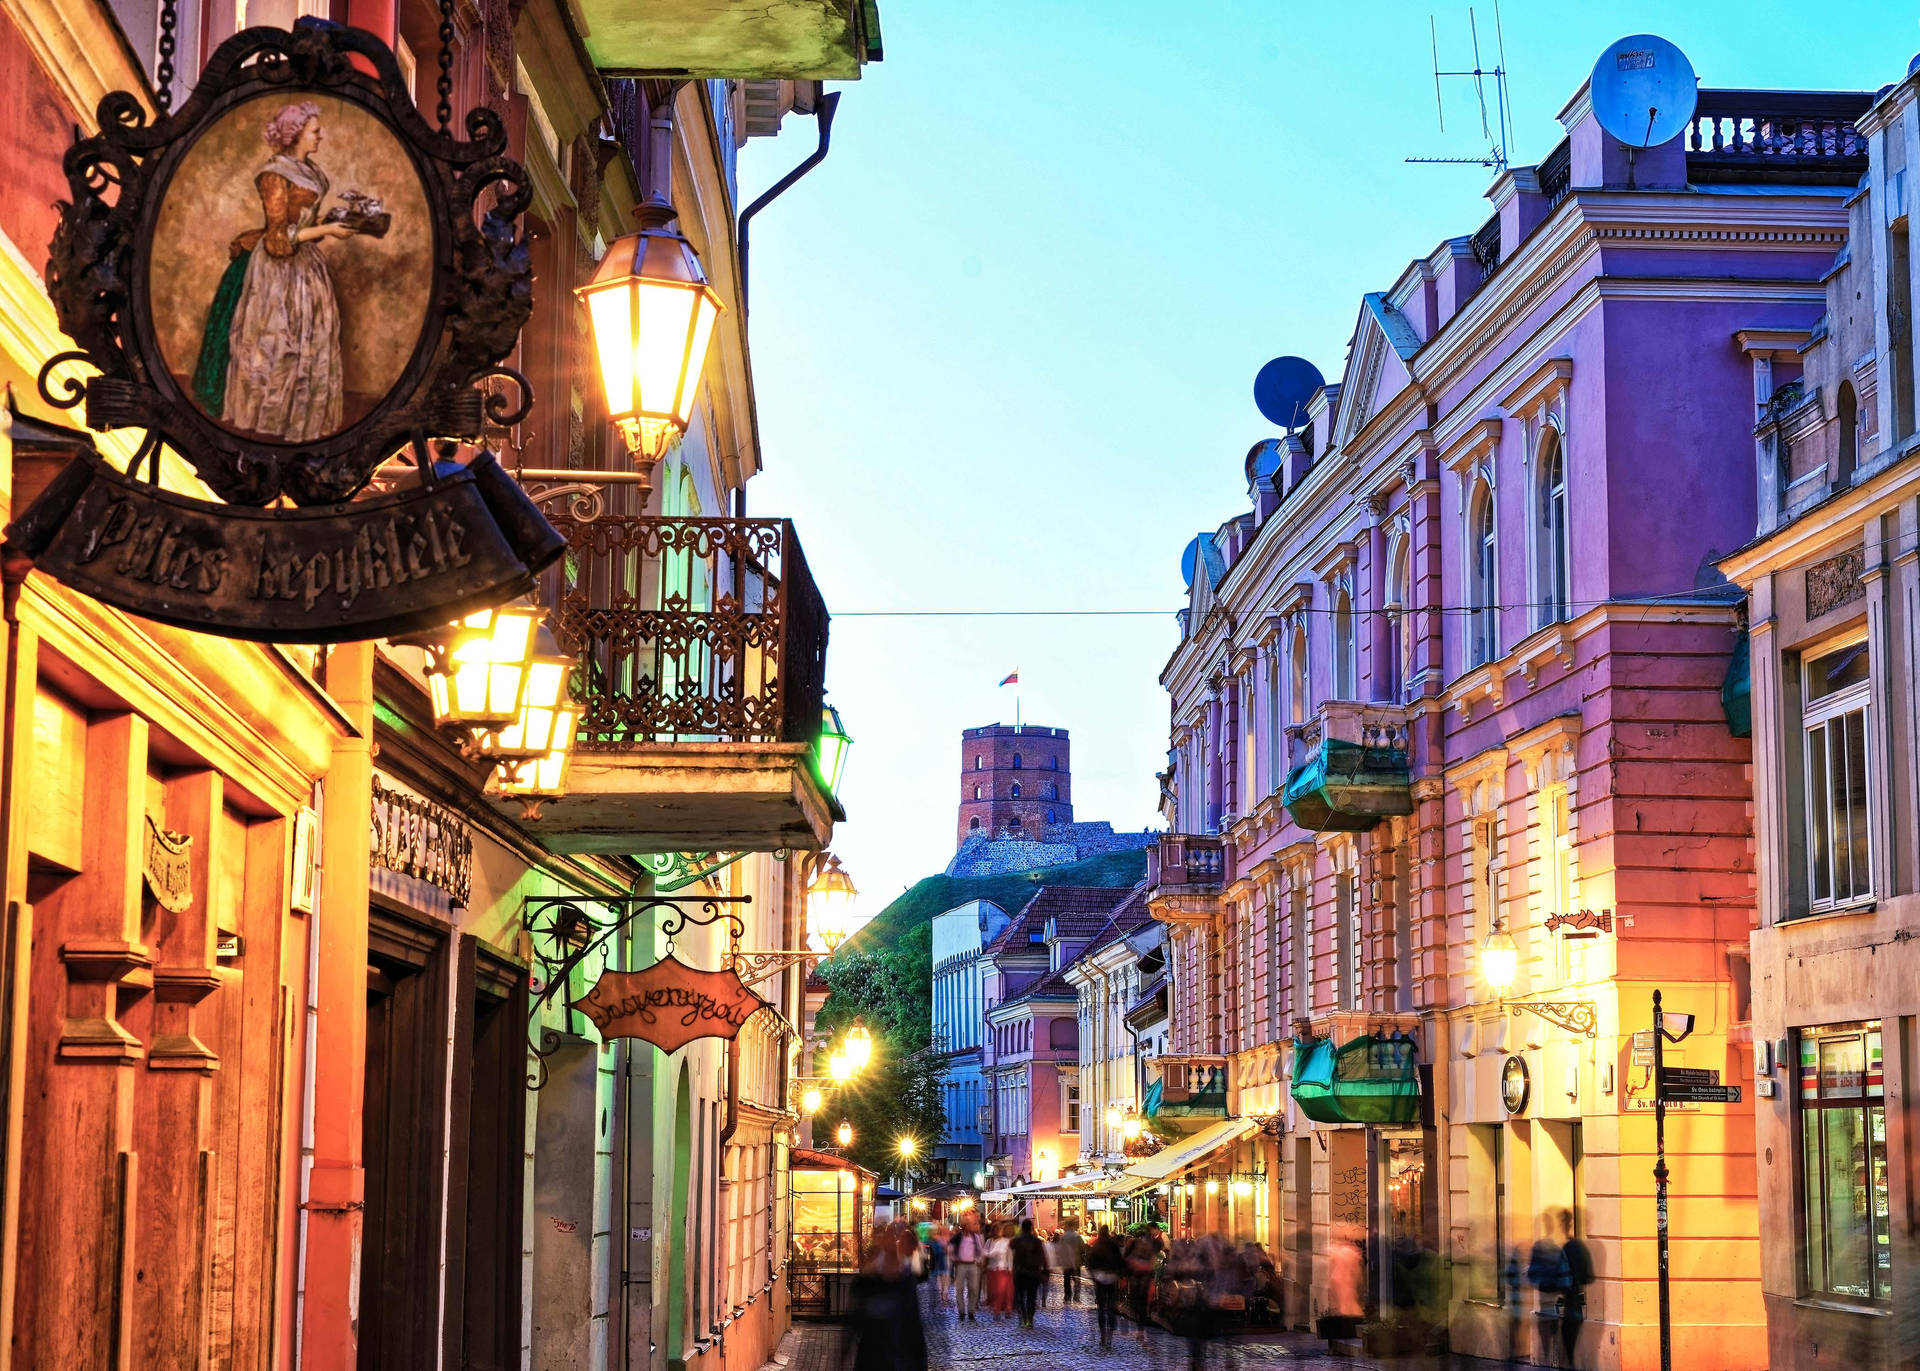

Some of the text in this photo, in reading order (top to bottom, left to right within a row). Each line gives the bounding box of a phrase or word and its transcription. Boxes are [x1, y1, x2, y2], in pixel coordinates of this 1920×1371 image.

[77, 499, 471, 612] Pilies kepyklėlė
[1637, 1099, 1648, 1108] Šv.
